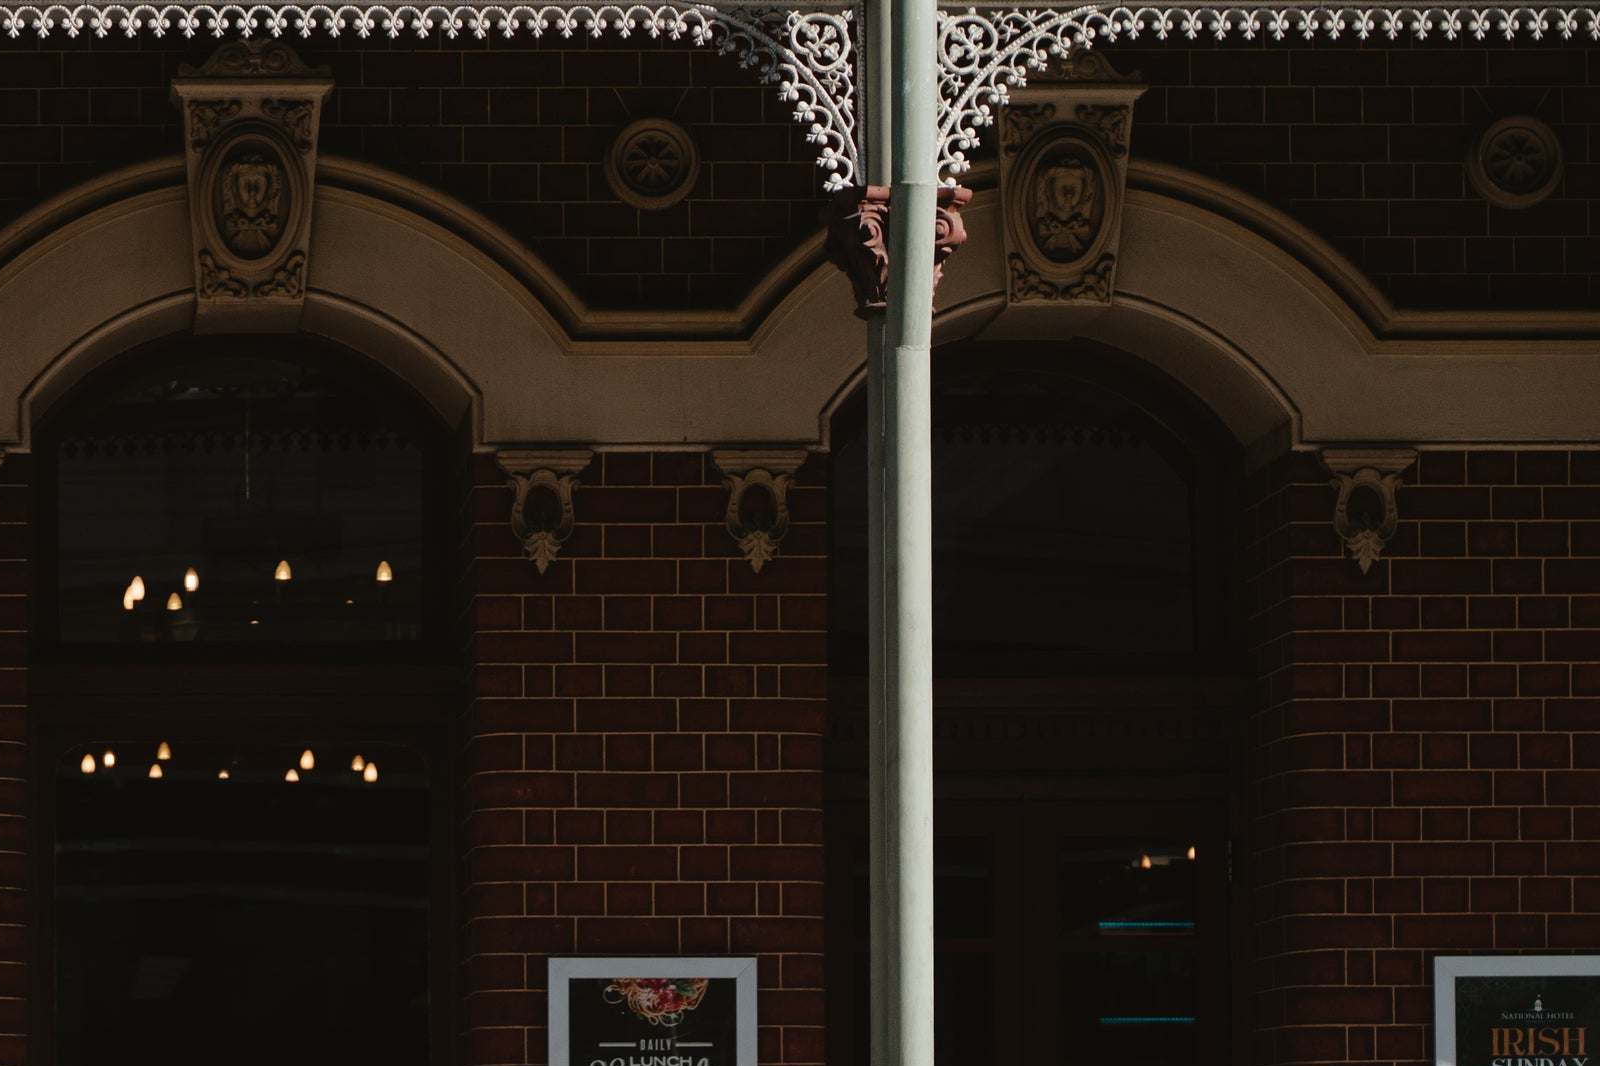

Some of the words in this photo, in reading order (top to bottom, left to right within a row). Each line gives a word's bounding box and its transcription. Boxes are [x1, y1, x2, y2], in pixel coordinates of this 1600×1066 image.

[1547, 1012, 1575, 1020] HOTEL
[640, 1039, 672, 1051] DAILY
[1491, 1027, 1587, 1056] IRISH
